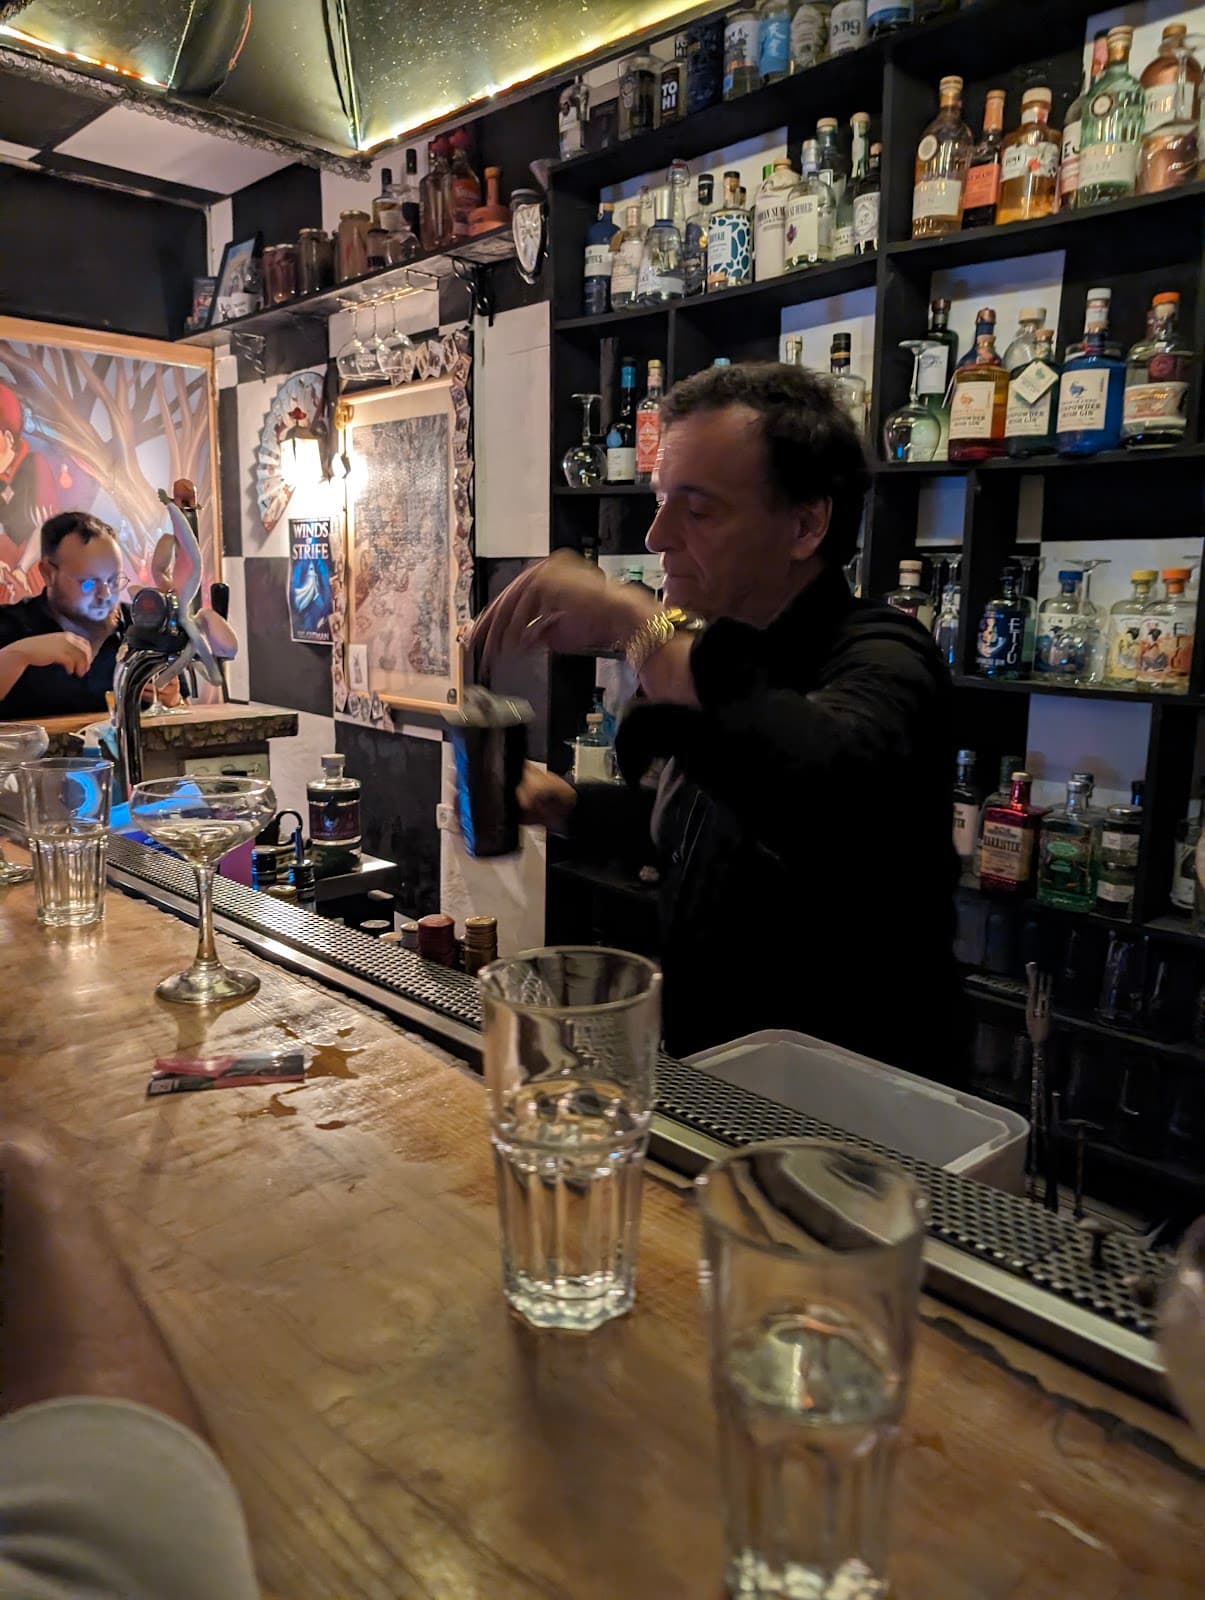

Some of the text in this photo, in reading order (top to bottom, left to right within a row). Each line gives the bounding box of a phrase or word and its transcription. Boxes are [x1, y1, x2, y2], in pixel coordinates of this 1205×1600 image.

[662, 81, 678, 96] TO
[662, 94, 676, 110] HI
[293, 522, 328, 538] WINDS
[292, 543, 328, 560] STRIFE
